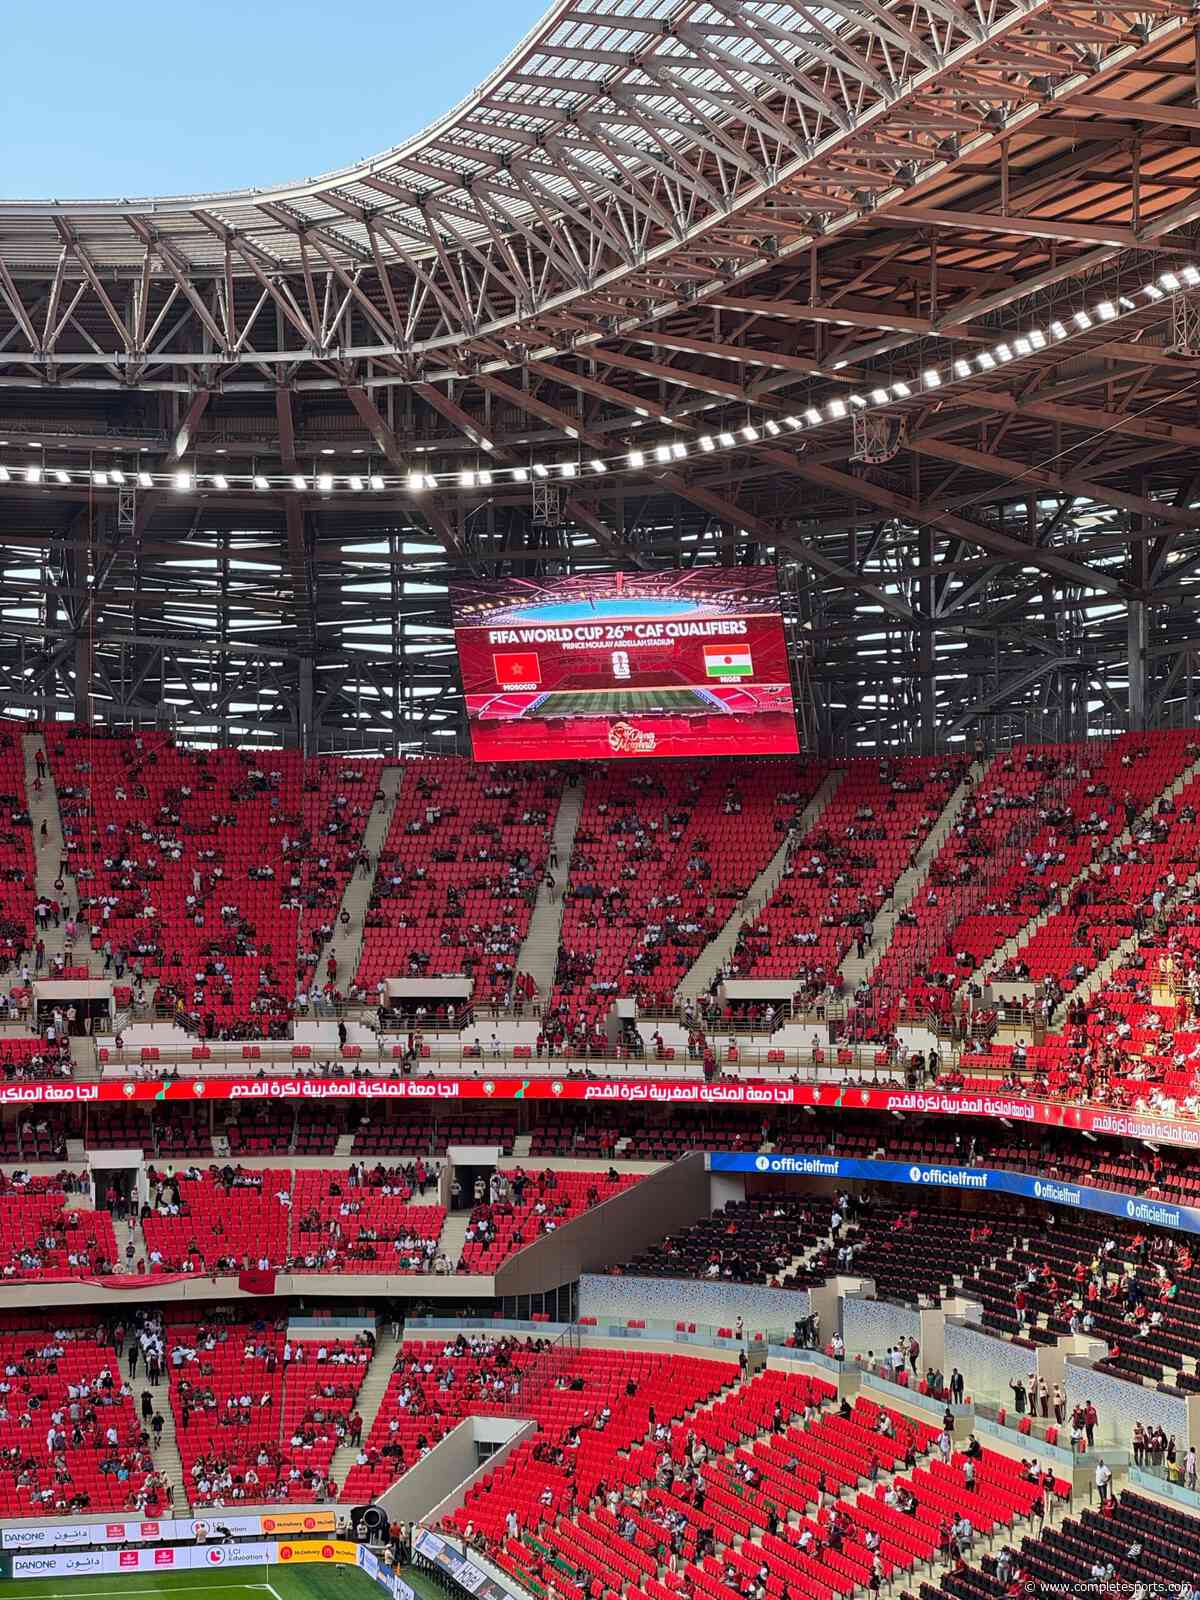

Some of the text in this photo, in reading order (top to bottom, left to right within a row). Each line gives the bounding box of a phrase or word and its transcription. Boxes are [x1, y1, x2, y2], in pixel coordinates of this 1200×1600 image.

[489, 630, 519, 644] FIFA
[519, 628, 573, 643] WORLD
[574, 626, 604, 641] CUP
[635, 623, 664, 638] CAF
[665, 620, 748, 637] QUALIFIERS
[503, 683, 537, 691] MOROCCO
[230, 1082, 269, 1099] القدم
[270, 1081, 300, 1098] لكرة
[302, 1081, 356, 1098] المغربية
[357, 1081, 405, 1098] الملكية
[584, 1083, 619, 1100] القدم
[621, 1083, 647, 1101] لكرة
[649, 1083, 698, 1101] المغربية
[700, 1085, 744, 1103] الملكية
[887, 1094, 915, 1111] القدم
[917, 1095, 940, 1112] لكرة
[941, 1095, 982, 1114] المغربية
[771, 1158, 839, 1175] officielfrmf
[922, 1168, 988, 1187] officielfrmf
[1042, 1184, 1081, 1205] officielfrmf
[1135, 1202, 1180, 1226] officielfrmf
